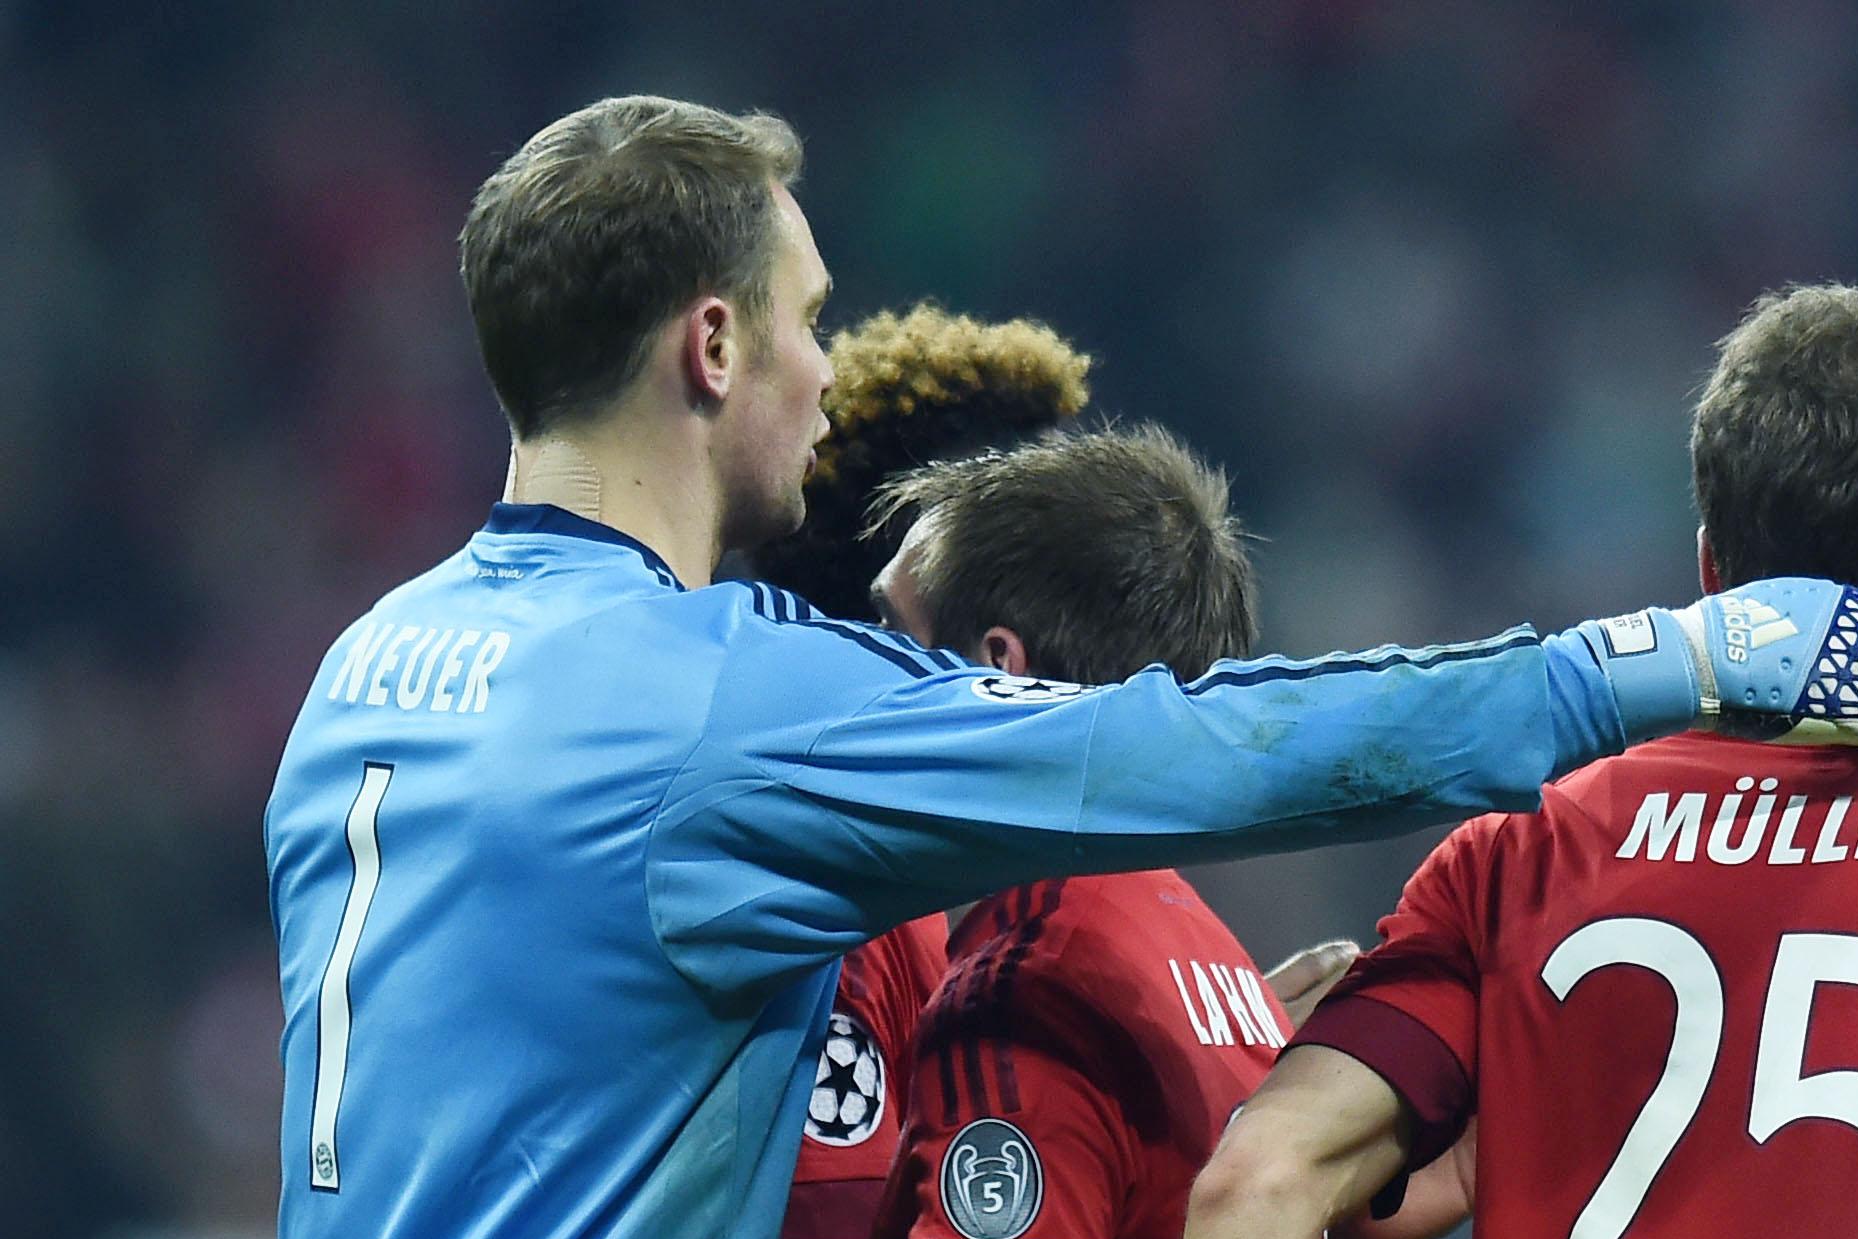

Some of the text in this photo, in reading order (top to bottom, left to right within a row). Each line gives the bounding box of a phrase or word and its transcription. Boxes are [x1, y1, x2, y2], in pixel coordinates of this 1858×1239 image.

[327, 623, 511, 713] NEUER
[311, 763, 393, 1190] 1
[981, 1181, 1004, 1213] 5
